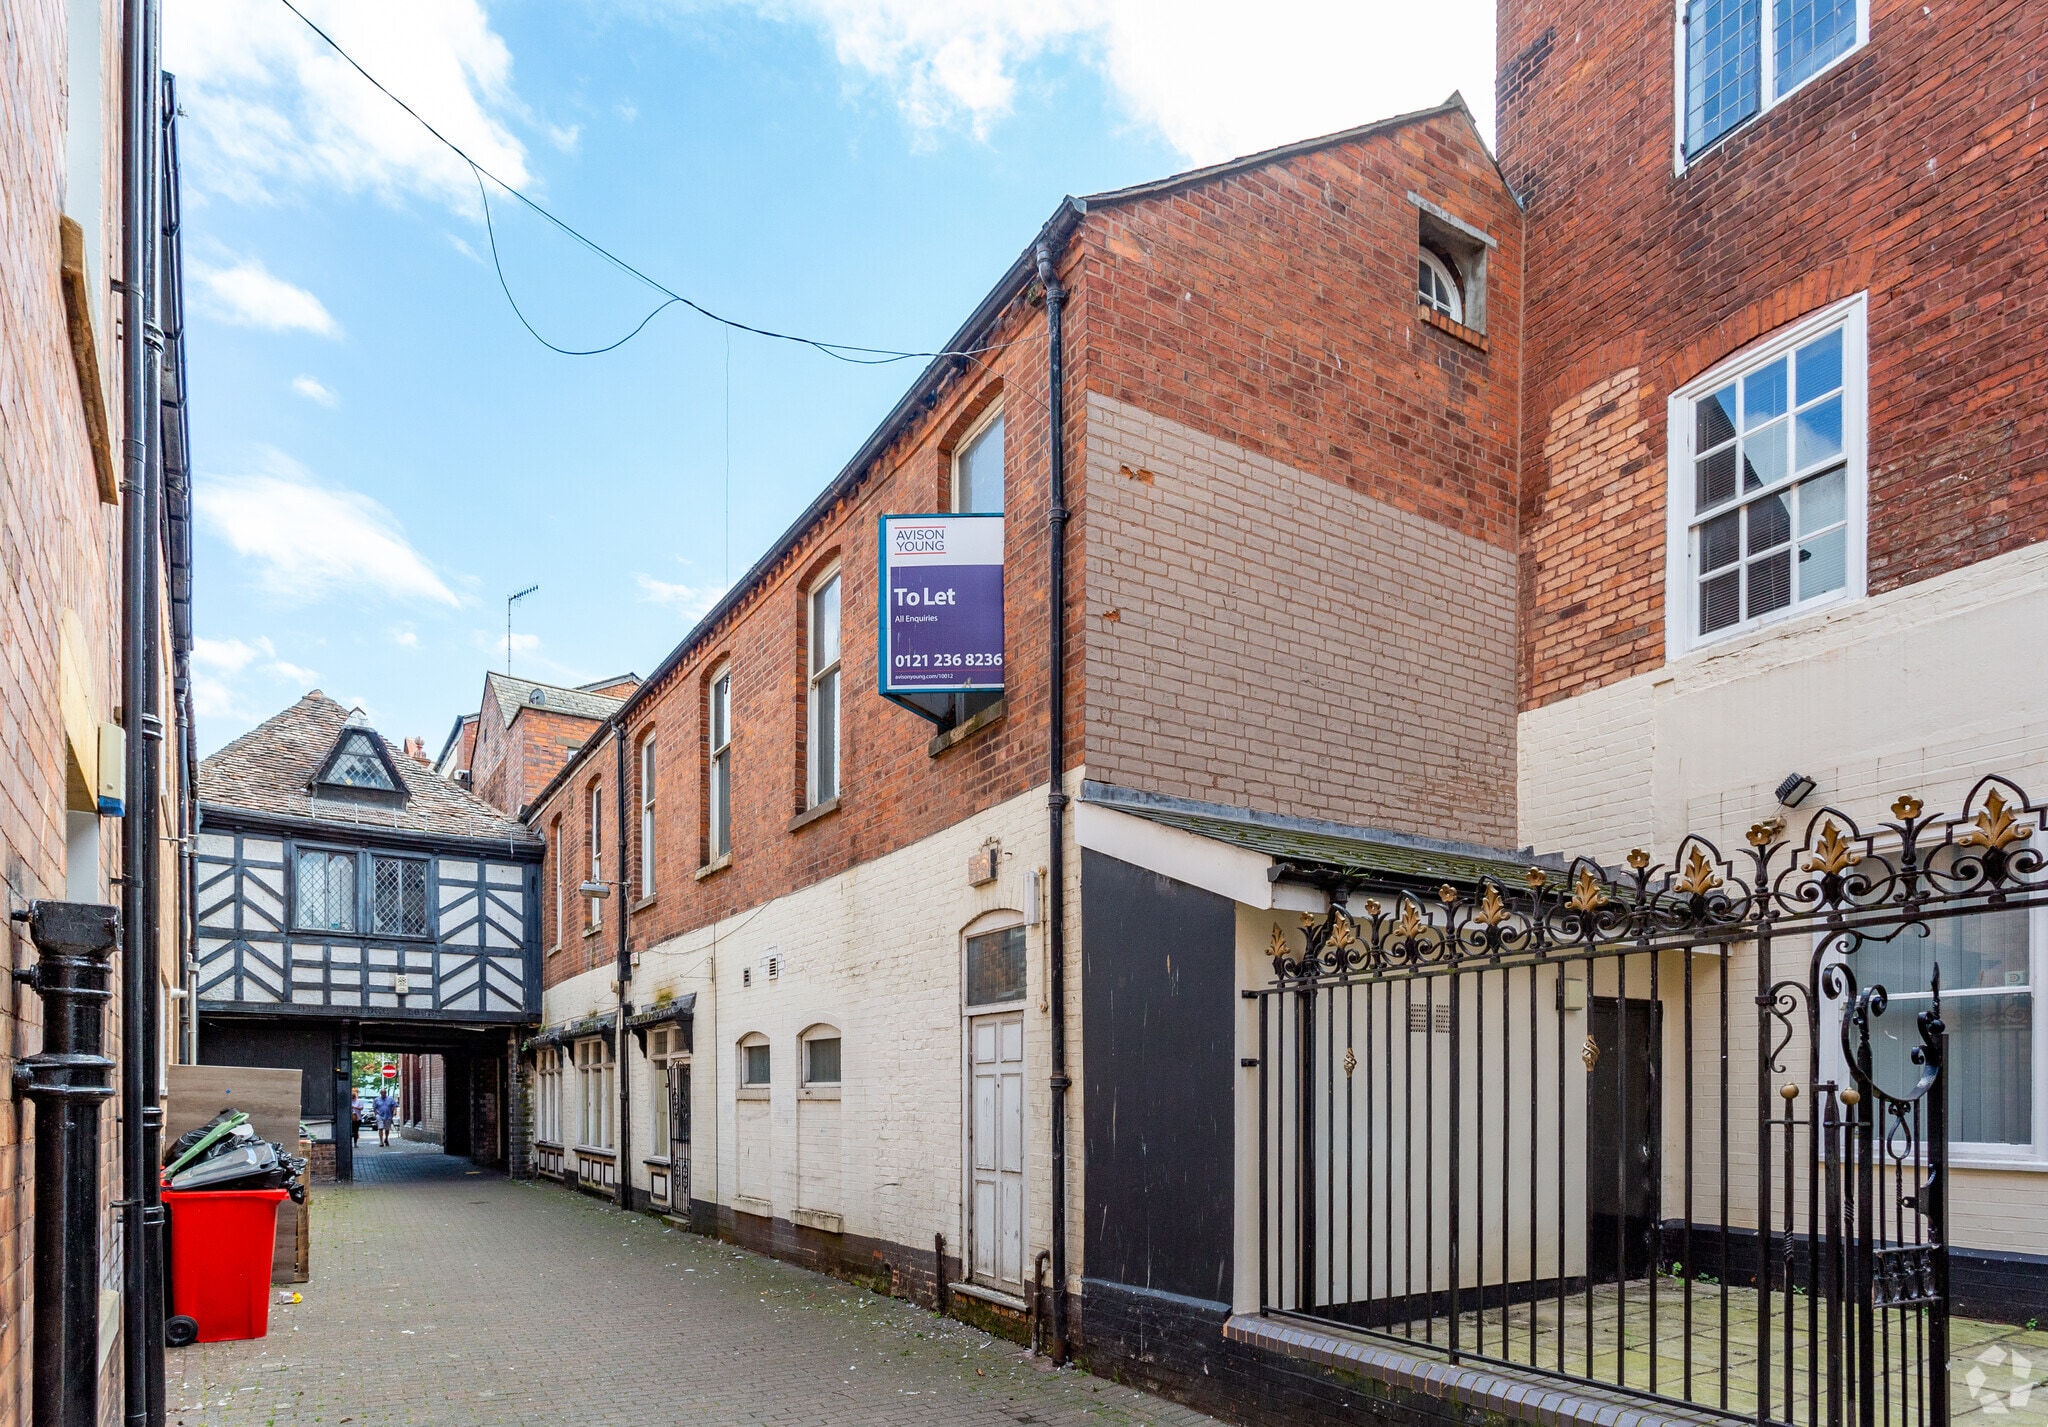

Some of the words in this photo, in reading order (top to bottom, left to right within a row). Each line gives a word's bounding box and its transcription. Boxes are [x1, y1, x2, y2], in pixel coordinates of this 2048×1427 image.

[896, 529, 945, 540] AVISON
[896, 540, 945, 552] YOUNG
[893, 588, 920, 606] To
[923, 587, 956, 606] Let
[895, 615, 904, 623] All
[905, 614, 938, 624] Enquiries
[895, 654, 928, 667] 0121
[933, 653, 962, 667] 236
[965, 653, 1003, 666] 8236
